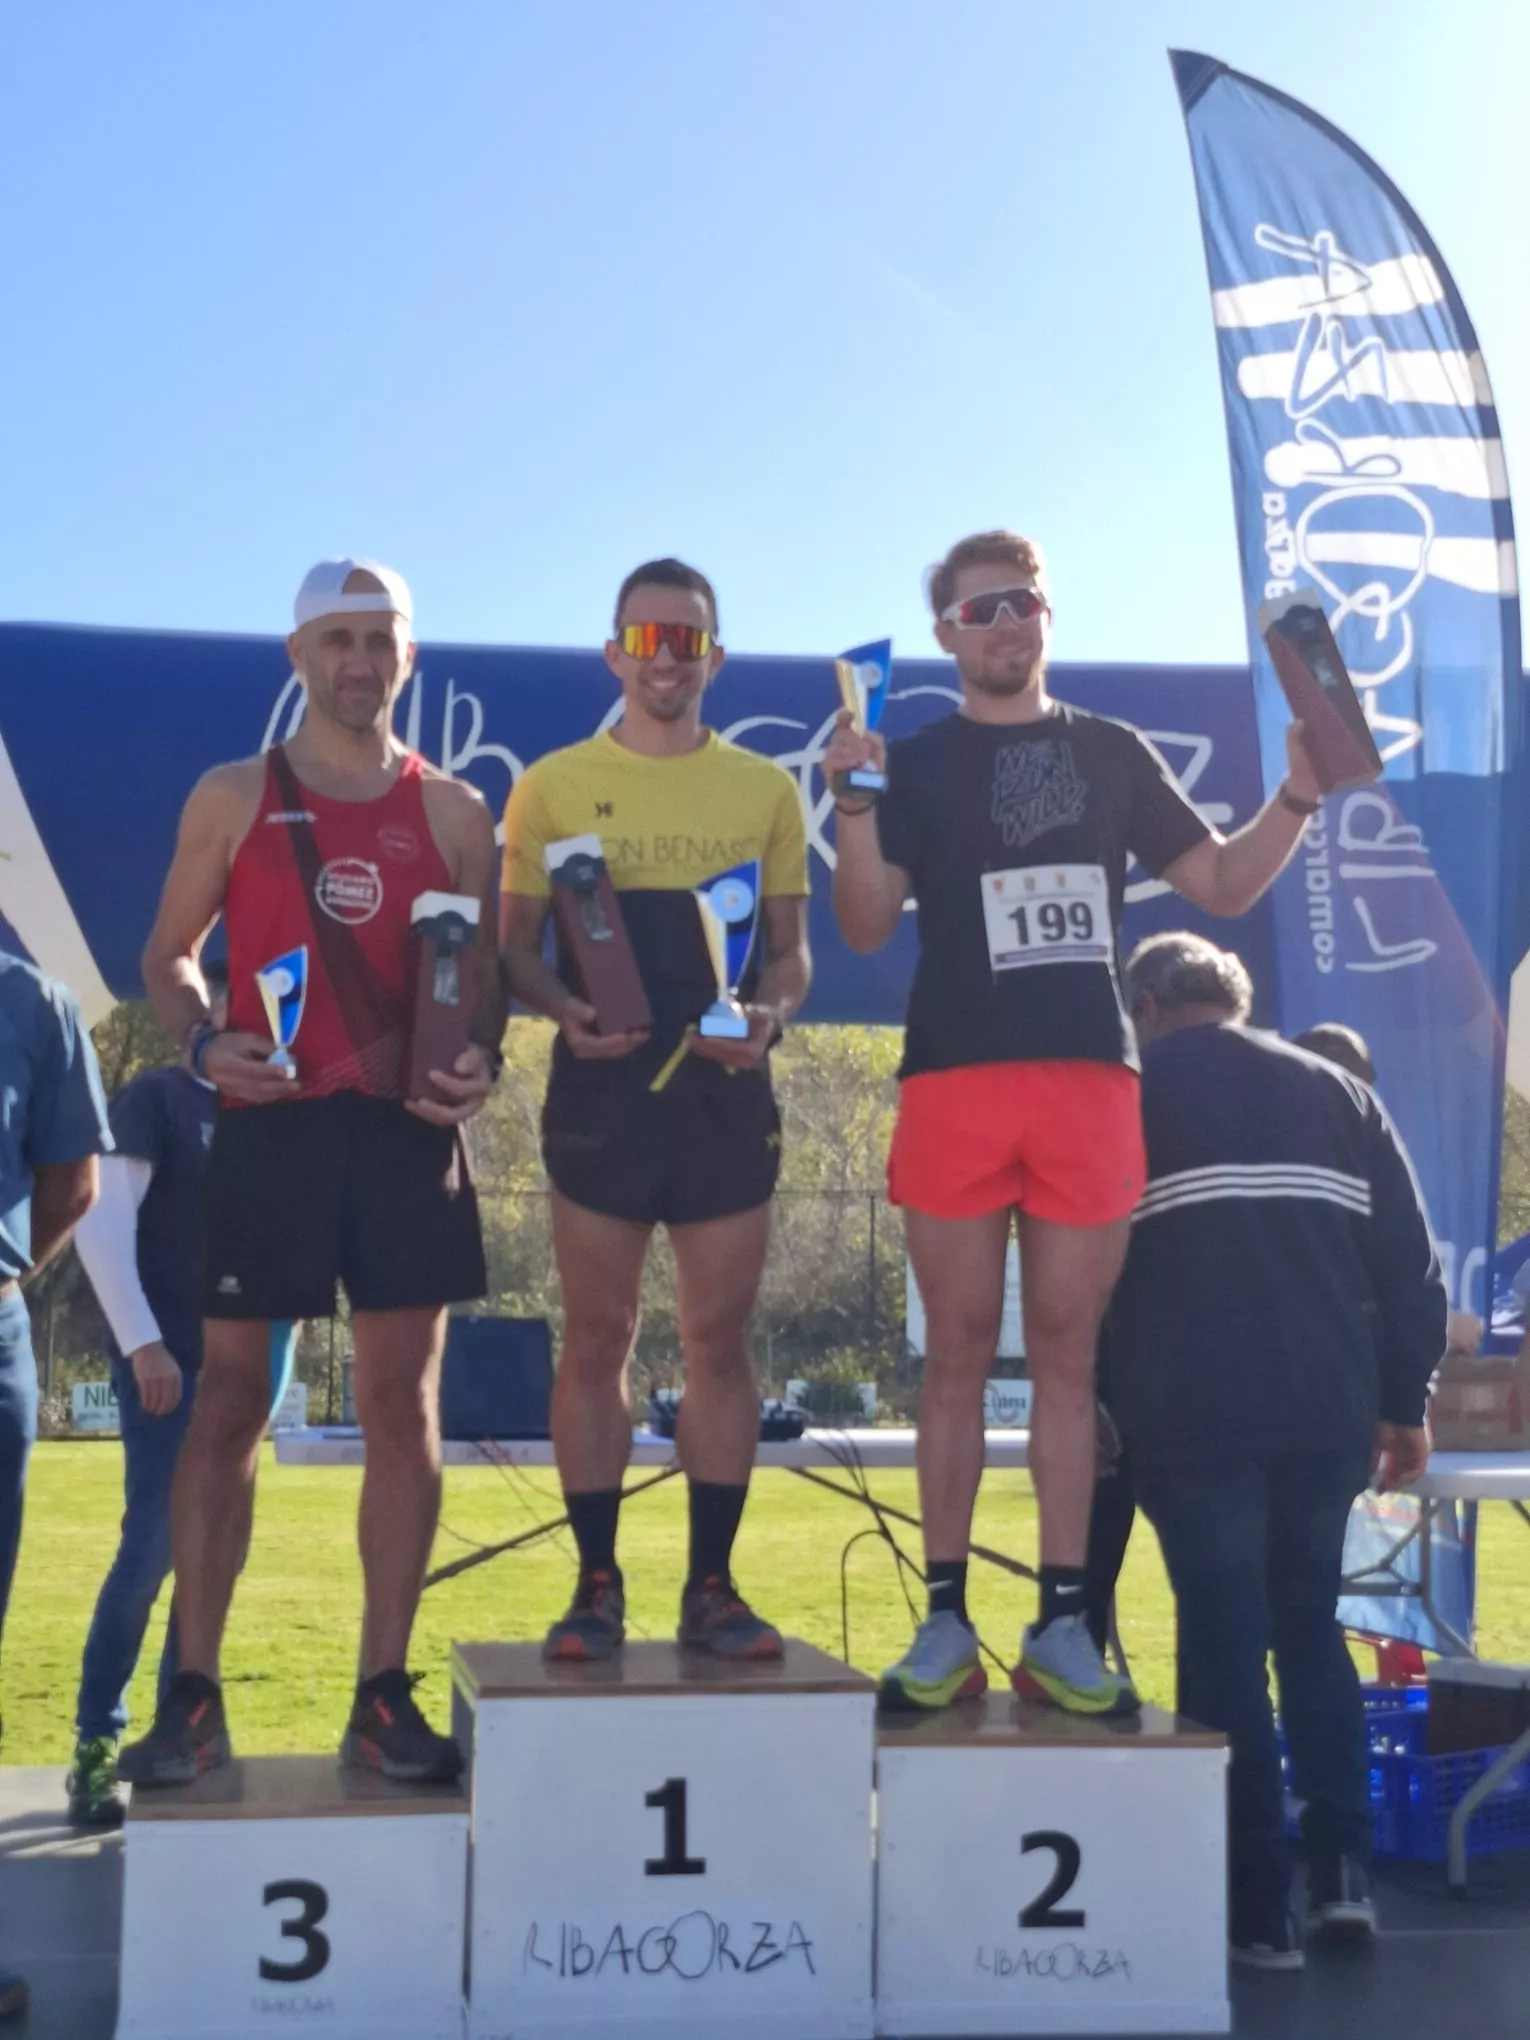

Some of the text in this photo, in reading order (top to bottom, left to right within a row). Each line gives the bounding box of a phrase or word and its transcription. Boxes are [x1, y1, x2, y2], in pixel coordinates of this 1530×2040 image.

[1007, 902, 1094, 946] 199
[644, 1777, 707, 1876] 1
[1018, 1830, 1086, 1929] 2
[258, 1877, 331, 1982] 3
